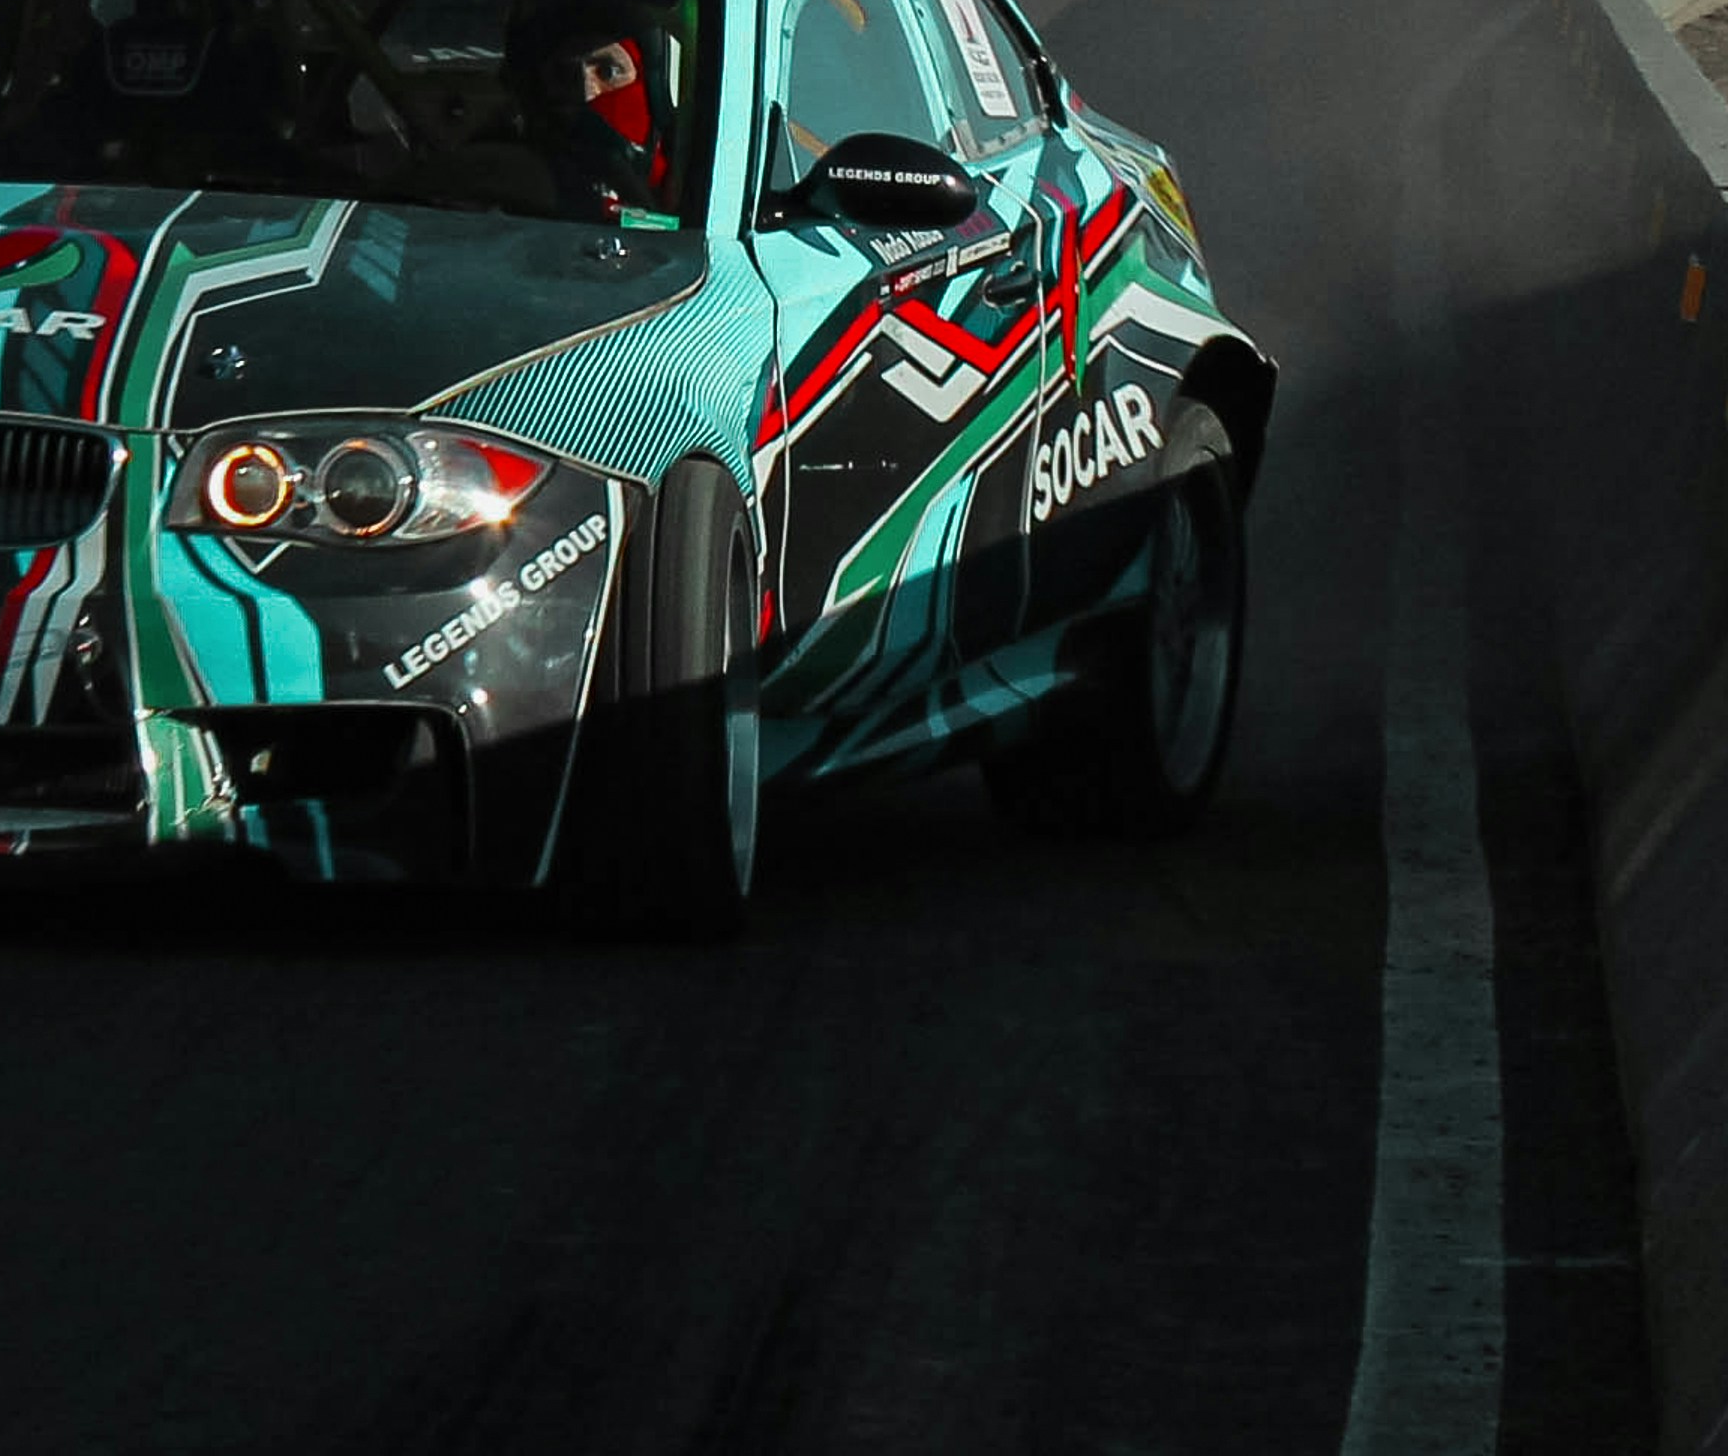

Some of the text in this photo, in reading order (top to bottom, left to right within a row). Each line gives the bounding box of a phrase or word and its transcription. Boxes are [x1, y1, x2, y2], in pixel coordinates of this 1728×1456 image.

[828, 166, 941, 186] LEGENDS GROUP
[1033, 383, 1165, 522] SOCAR
[382, 513, 608, 691] LEGENDS GROUP
